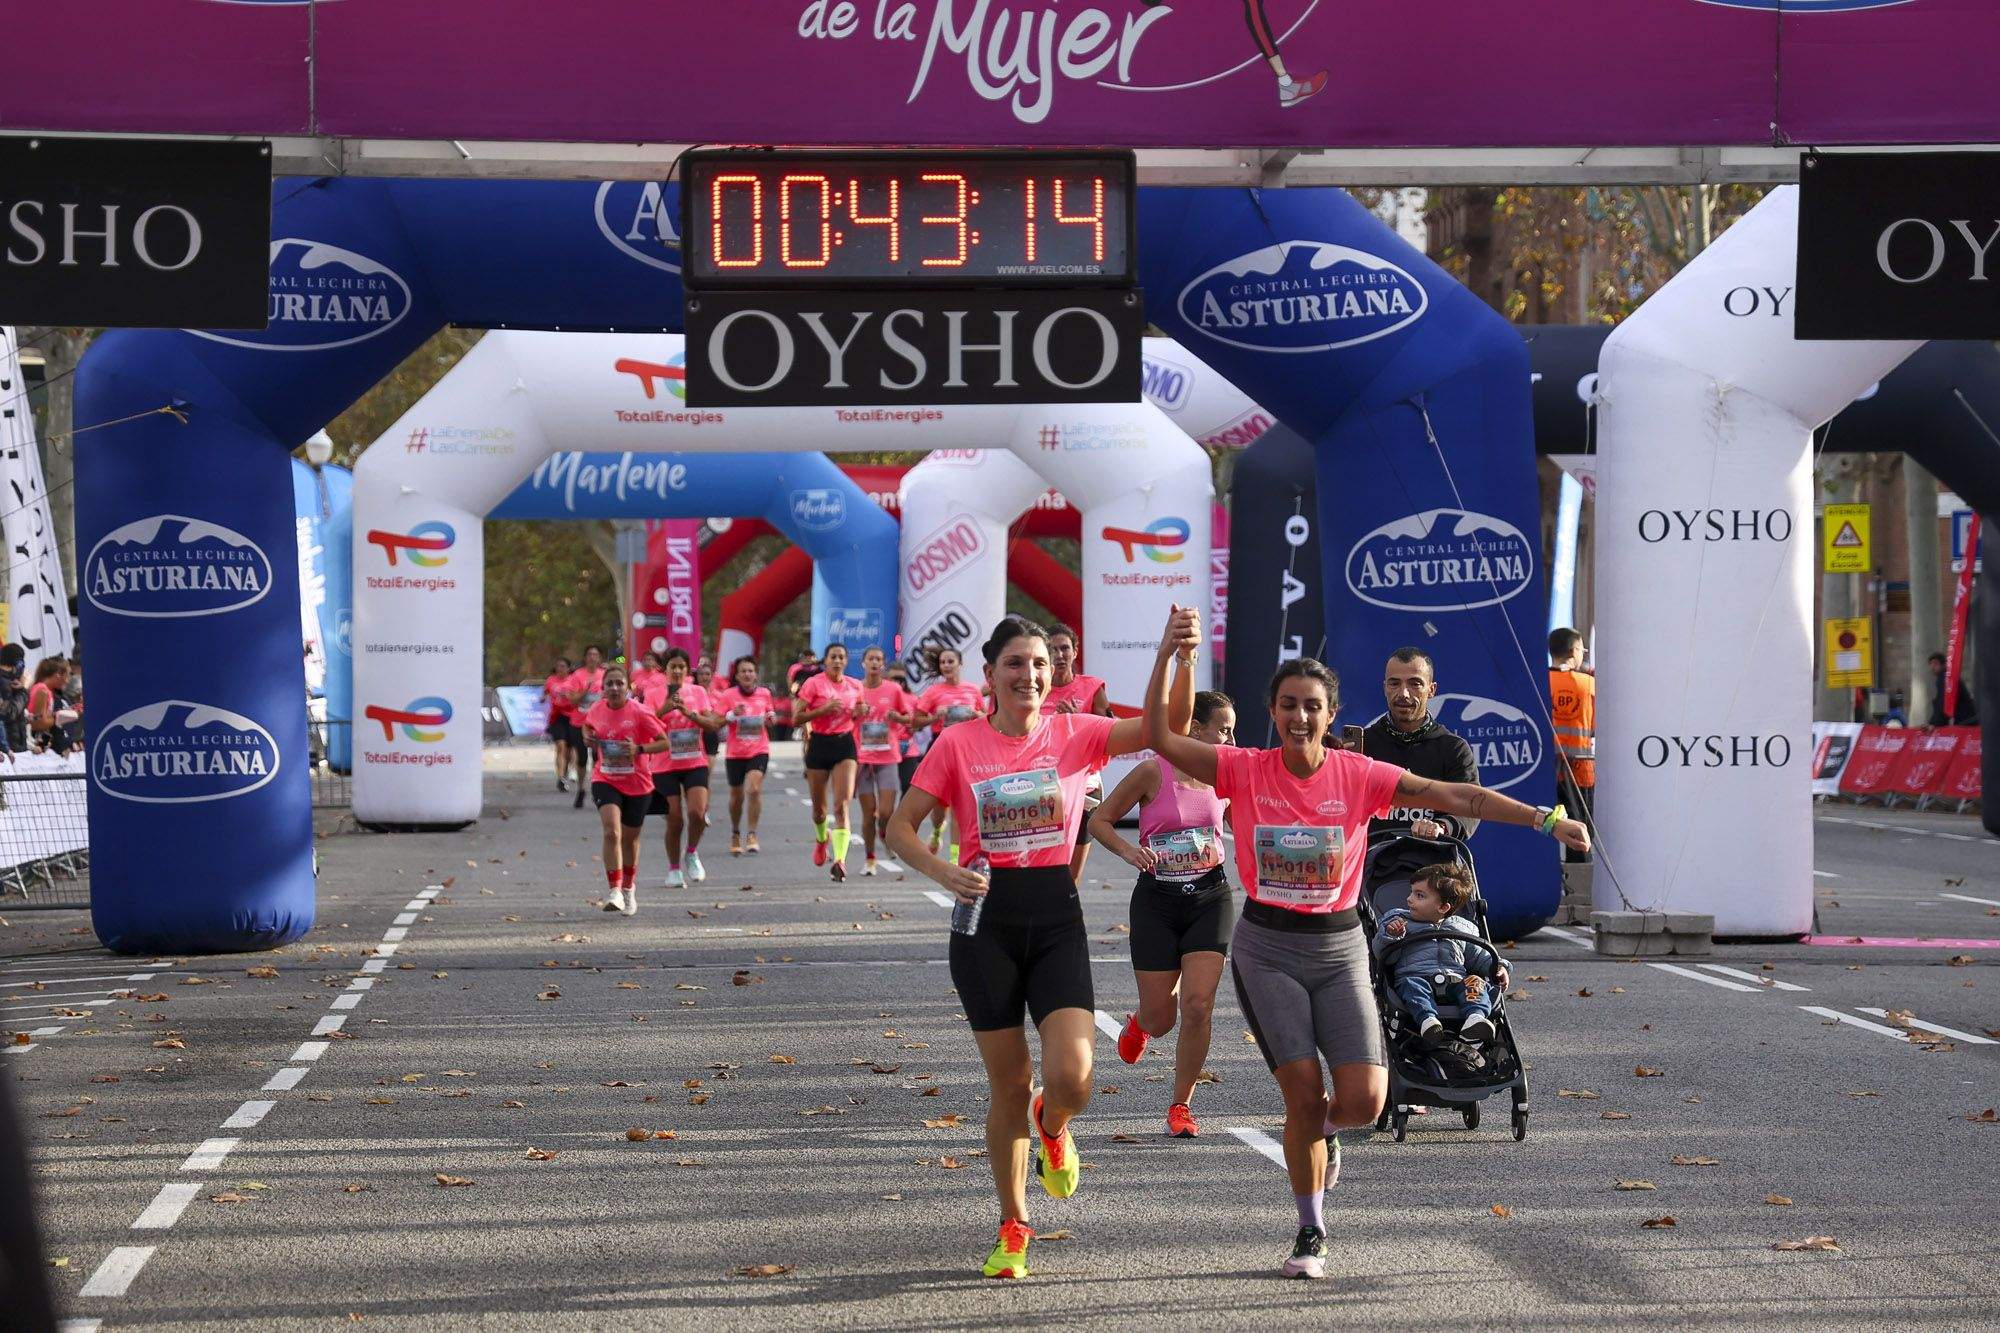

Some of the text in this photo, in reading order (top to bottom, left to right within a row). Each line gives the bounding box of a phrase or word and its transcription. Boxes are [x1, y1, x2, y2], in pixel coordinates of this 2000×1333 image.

[798, 0, 1173, 124] de la Mujer
[0, 200, 202, 270] SHO
[997, 264, 1101, 276] WWW.PIXELCOM.ES
[307, 277, 388, 290] LECHERA
[1230, 273, 1399, 296] CENTRAL LECHERA
[1200, 288, 1414, 328] ASTURIANA
[1724, 286, 1792, 317] OY
[707, 306, 1120, 392] OYSHO
[614, 409, 724, 426] TotalEnergies
[835, 408, 944, 424] TotalEnergies
[533, 451, 687, 512] Marlene
[1638, 508, 1793, 543] OYSHO
[114, 550, 253, 562] CENTRAL LECHERA
[908, 523, 978, 590] COSMO
[1385, 540, 1520, 557] CENTRAL LECHERA
[93, 557, 261, 596] ASTURIANA
[1358, 550, 1526, 589] ASTURIANA
[366, 576, 456, 590] TotalEnergies
[1102, 572, 1192, 588] TotalEnergies
[365, 643, 454, 654] totalenergies.es
[1468, 725, 1529, 737] LECHERA
[121, 735, 261, 748] CENTRAL LECHERA
[363, 752, 453, 767] TotalEnergies
[1637, 734, 1791, 769] OYSHO
[100, 742, 268, 781] ASTURIANA
[971, 763, 1006, 774] OYSHO
[1256, 795, 1290, 808] OYSHO
[990, 841, 1017, 849] OYSHO
[1267, 888, 1292, 899] OYSHO
